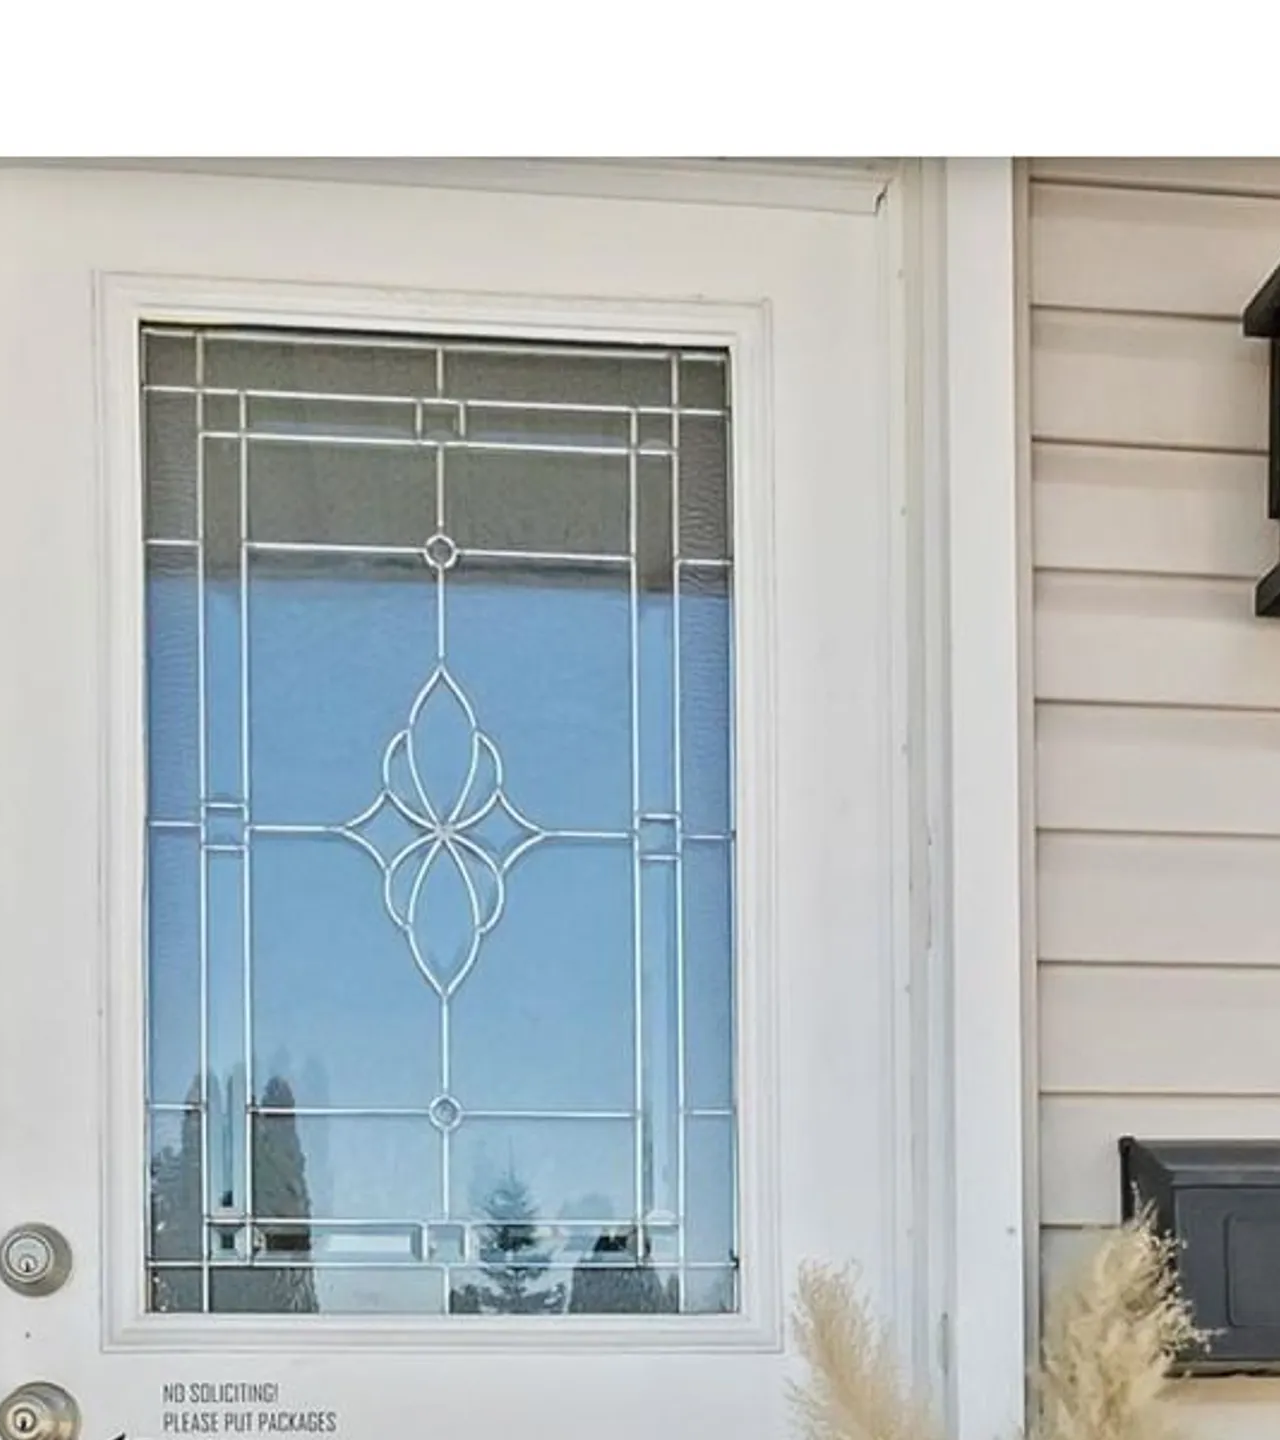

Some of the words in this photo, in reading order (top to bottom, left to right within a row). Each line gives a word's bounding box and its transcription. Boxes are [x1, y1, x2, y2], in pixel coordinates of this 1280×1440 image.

[163, 1383, 185, 1402] NO
[190, 1383, 279, 1402] SOLICITING!
[163, 1412, 219, 1432] PLEASE
[224, 1412, 253, 1432] PUT
[258, 1412, 337, 1432] PACKAGES
